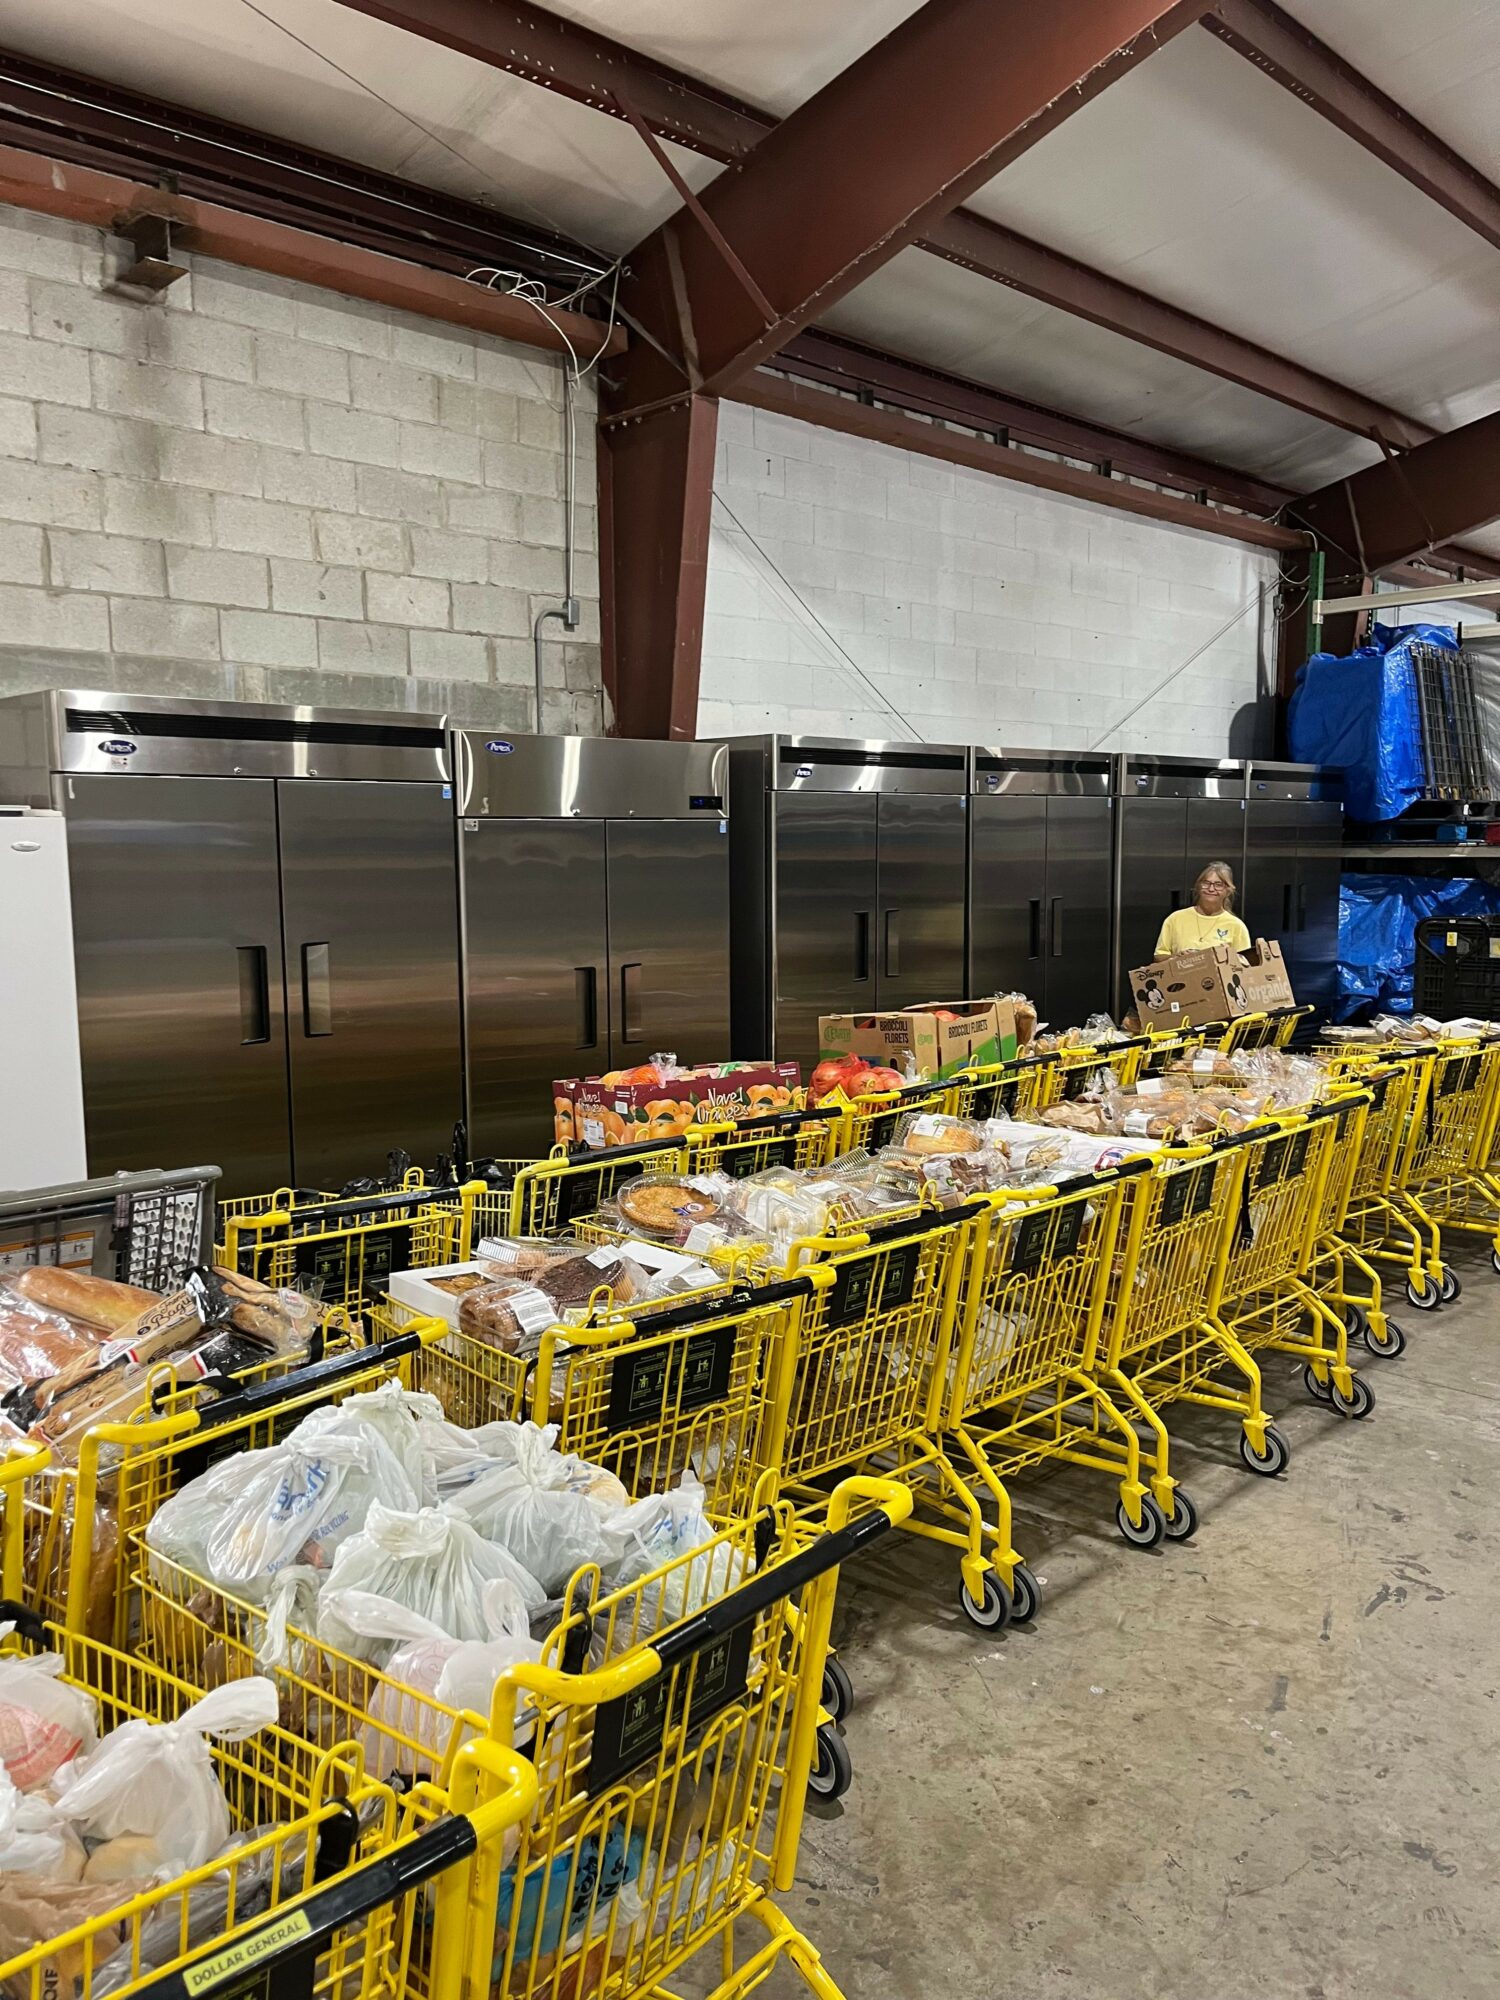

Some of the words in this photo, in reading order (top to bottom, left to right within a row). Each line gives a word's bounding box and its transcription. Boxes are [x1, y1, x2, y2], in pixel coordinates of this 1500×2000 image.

[1134, 968, 1165, 982] Disney
[1248, 978, 1291, 1003] organic
[880, 1021, 908, 1032] BROCCOLI
[948, 1025, 971, 1039] BROCCOLI
[970, 1019, 988, 1033] FLORETS
[884, 1033, 909, 1044] FLORETS
[582, 1087, 601, 1103] Navel
[707, 1086, 743, 1107] Navel
[192, 1952, 245, 1987] DOLLAR
[246, 1921, 303, 1957] GENERAL
